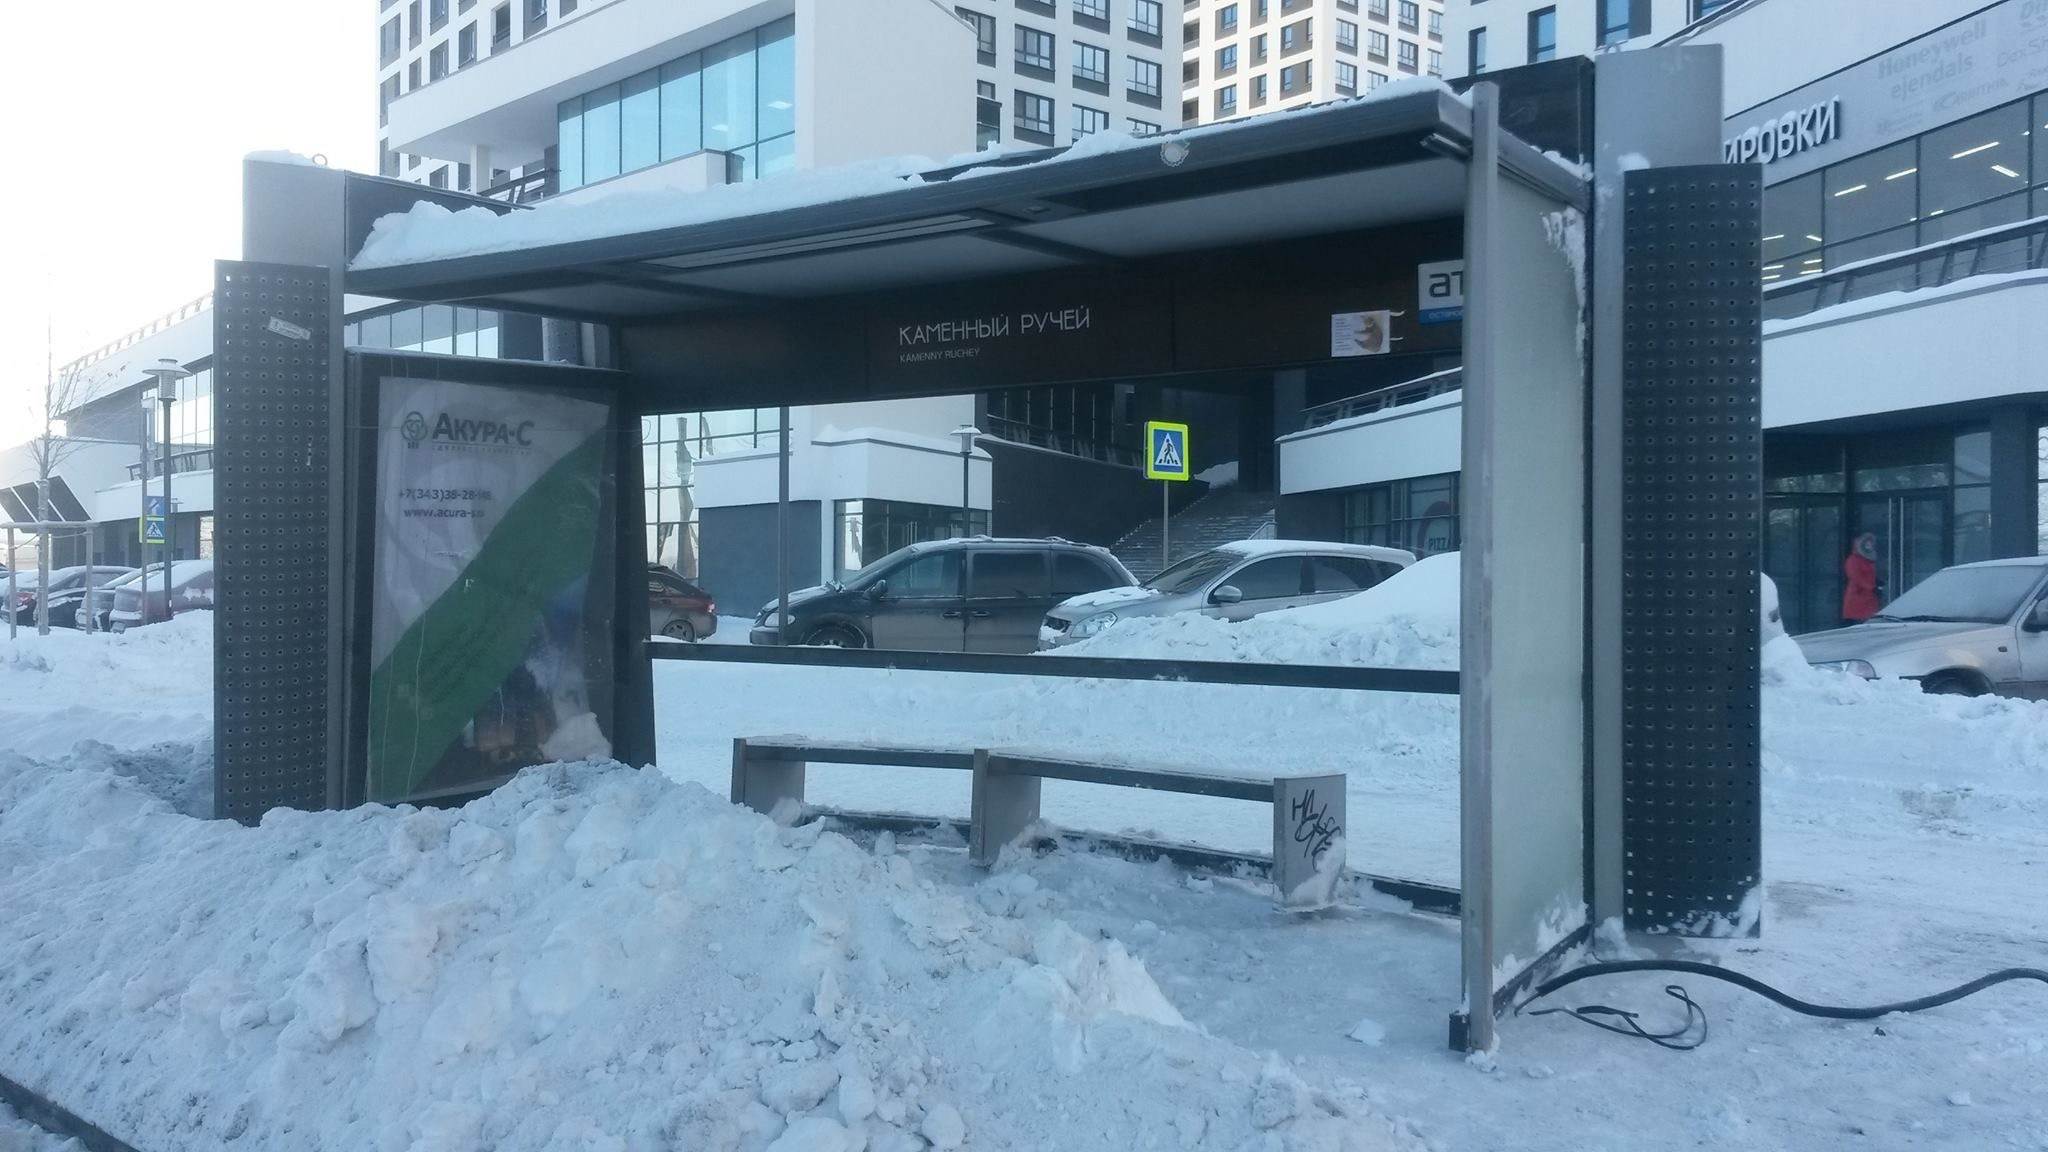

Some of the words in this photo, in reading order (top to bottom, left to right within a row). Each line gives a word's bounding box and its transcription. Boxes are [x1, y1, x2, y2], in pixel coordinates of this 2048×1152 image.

[1877, 18, 1987, 80] Honeywell
[1891, 52, 1973, 101] ejendals
[1724, 95, 1840, 164] ИРОВКИ
[900, 313, 1009, 346] КАМЕННЫЙ
[1021, 305, 1090, 334] РУЧЕЙ
[900, 351, 943, 363] KAMENNY
[945, 347, 980, 359] RUCHEY
